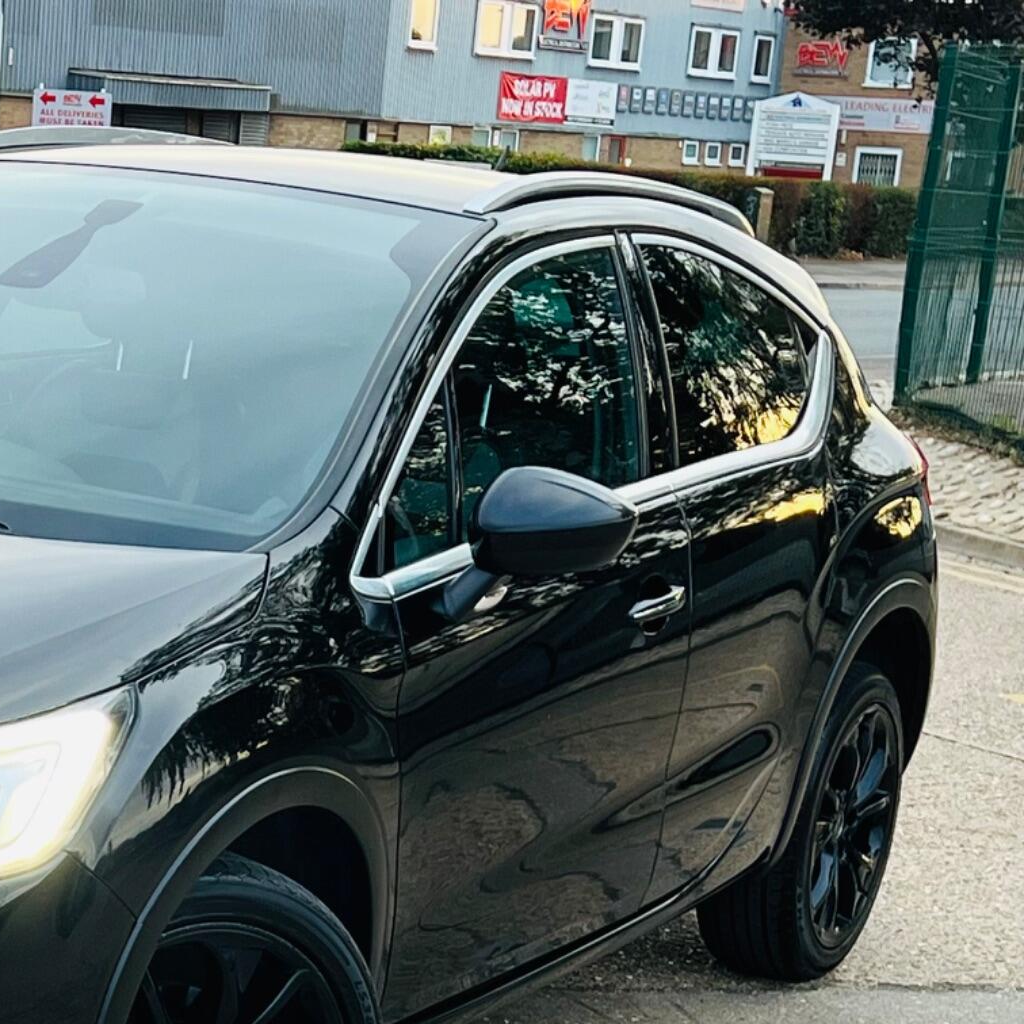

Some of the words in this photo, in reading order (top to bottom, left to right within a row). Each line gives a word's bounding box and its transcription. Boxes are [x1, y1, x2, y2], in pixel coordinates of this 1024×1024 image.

[514, 79, 543, 97] SOLAR
[543, 81, 556, 98] PV
[40, 108, 54, 116] ALL
[57, 109, 104, 119] DELIVERIES
[501, 98, 524, 116] NOW
[524, 100, 535, 116] IN
[535, 100, 564, 119] STOCK
[39, 118, 62, 126] MUST
[64, 118, 74, 126] BE
